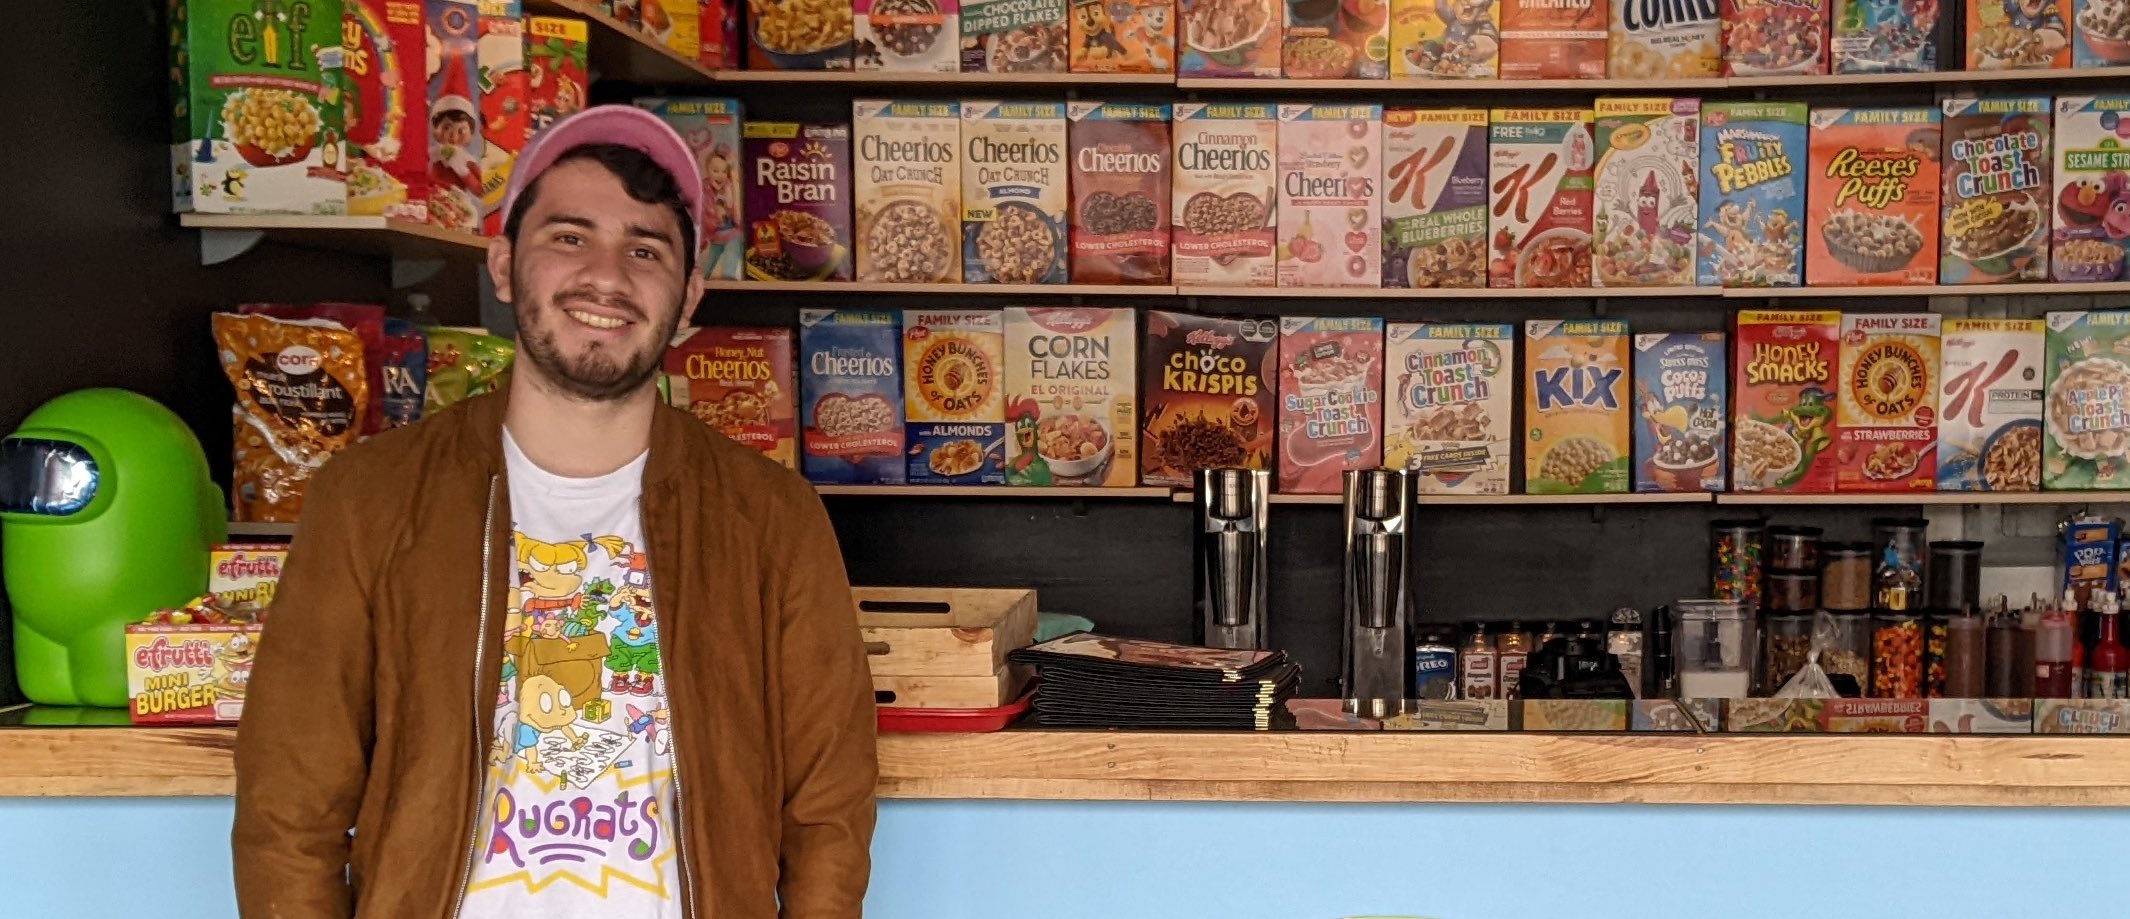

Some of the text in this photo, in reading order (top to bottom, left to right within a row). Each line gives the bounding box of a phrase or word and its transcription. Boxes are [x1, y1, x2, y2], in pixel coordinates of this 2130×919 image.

[535, 22, 566, 34] SIZE
[963, 8, 1059, 32] DIPPED FLAKES
[1311, 107, 1348, 119] FAMILY
[1599, 103, 1640, 112] FAMILY
[1642, 103, 1668, 112] SIZE
[1730, 107, 1787, 117] FAMILY SIZE
[1979, 101, 2039, 112] FAMILY SIZE
[2095, 100, 2129, 111] FAMILY
[1420, 113, 1486, 122] FAMILY SIZE
[1503, 110, 1581, 121] FAMILY SIZE
[1854, 110, 1929, 123] FAMILY SIZE
[1197, 131, 1258, 146] Cinnamon
[1492, 125, 1523, 138] FREE
[861, 134, 954, 163] Cheerios
[968, 136, 1060, 164] Cheerios
[1951, 132, 2038, 160] Chocolate
[1078, 147, 1161, 174] Cheerios
[1178, 142, 1271, 171] Cheerios
[1826, 146, 1920, 178] Reese's
[2067, 153, 2109, 169] SESAME
[757, 158, 835, 186] Raisin
[1387, 135, 1456, 210] K
[1711, 155, 1792, 195] PEBBLES
[1957, 162, 2040, 197] Crunch
[777, 180, 836, 204] Bran
[1492, 152, 1558, 223] K
[1835, 177, 1908, 209] Puffs
[1560, 197, 1577, 206] Red
[967, 209, 994, 219] NEW
[1411, 208, 1485, 229] REAL WHOLE
[1552, 206, 1583, 216] Berries
[1402, 220, 1485, 243] BLUEBERRIES
[1075, 238, 1165, 250] LOWER CHOLESTEROL
[1179, 238, 1270, 250] LOWER CHOLESTEROL
[917, 314, 992, 326] FAMILY SIZE
[1313, 320, 1348, 332] FAMILY
[1756, 313, 1824, 322] FAMILY SIZE
[1855, 318, 1929, 329] FAMILY SIZE
[2087, 312, 2120, 325] FAMILY
[1428, 327, 1500, 338] FAMILY SIZE
[1563, 322, 1599, 334] FAMILY
[1955, 322, 2033, 332] FAMILY SIZE
[714, 346, 766, 359] Honey Nut
[1028, 335, 1109, 359] CORN
[686, 354, 771, 381] Cheerios
[811, 351, 894, 377] Cheerios
[922, 341, 989, 385] HONEY BUNCHES
[1406, 348, 1489, 372] Cinnamon
[1857, 345, 1922, 389] HONEY BUNCHES
[1031, 360, 1110, 380] FLAKES
[1661, 369, 1707, 387] Cocoa
[1030, 384, 1110, 396] EL ORIGINAL
[1412, 376, 1489, 407] Crunch
[1534, 365, 1623, 411] KIX
[1942, 348, 2020, 429] K
[1990, 390, 2030, 400] PROTEIN
[943, 390, 983, 411] OATS
[1876, 395, 1915, 415] OATS
[1699, 407, 1717, 418] HOT
[932, 425, 992, 437] ALMONDS
[1306, 415, 1369, 438] Crunch
[1854, 429, 1931, 441] STRAWBERRIES
[809, 438, 899, 450] LOWER CHOLESTEROL
[1408, 453, 1423, 471] 3
[134, 635, 216, 674] efrutti
[143, 671, 190, 693] MINI
[135, 682, 216, 716] BURGER
